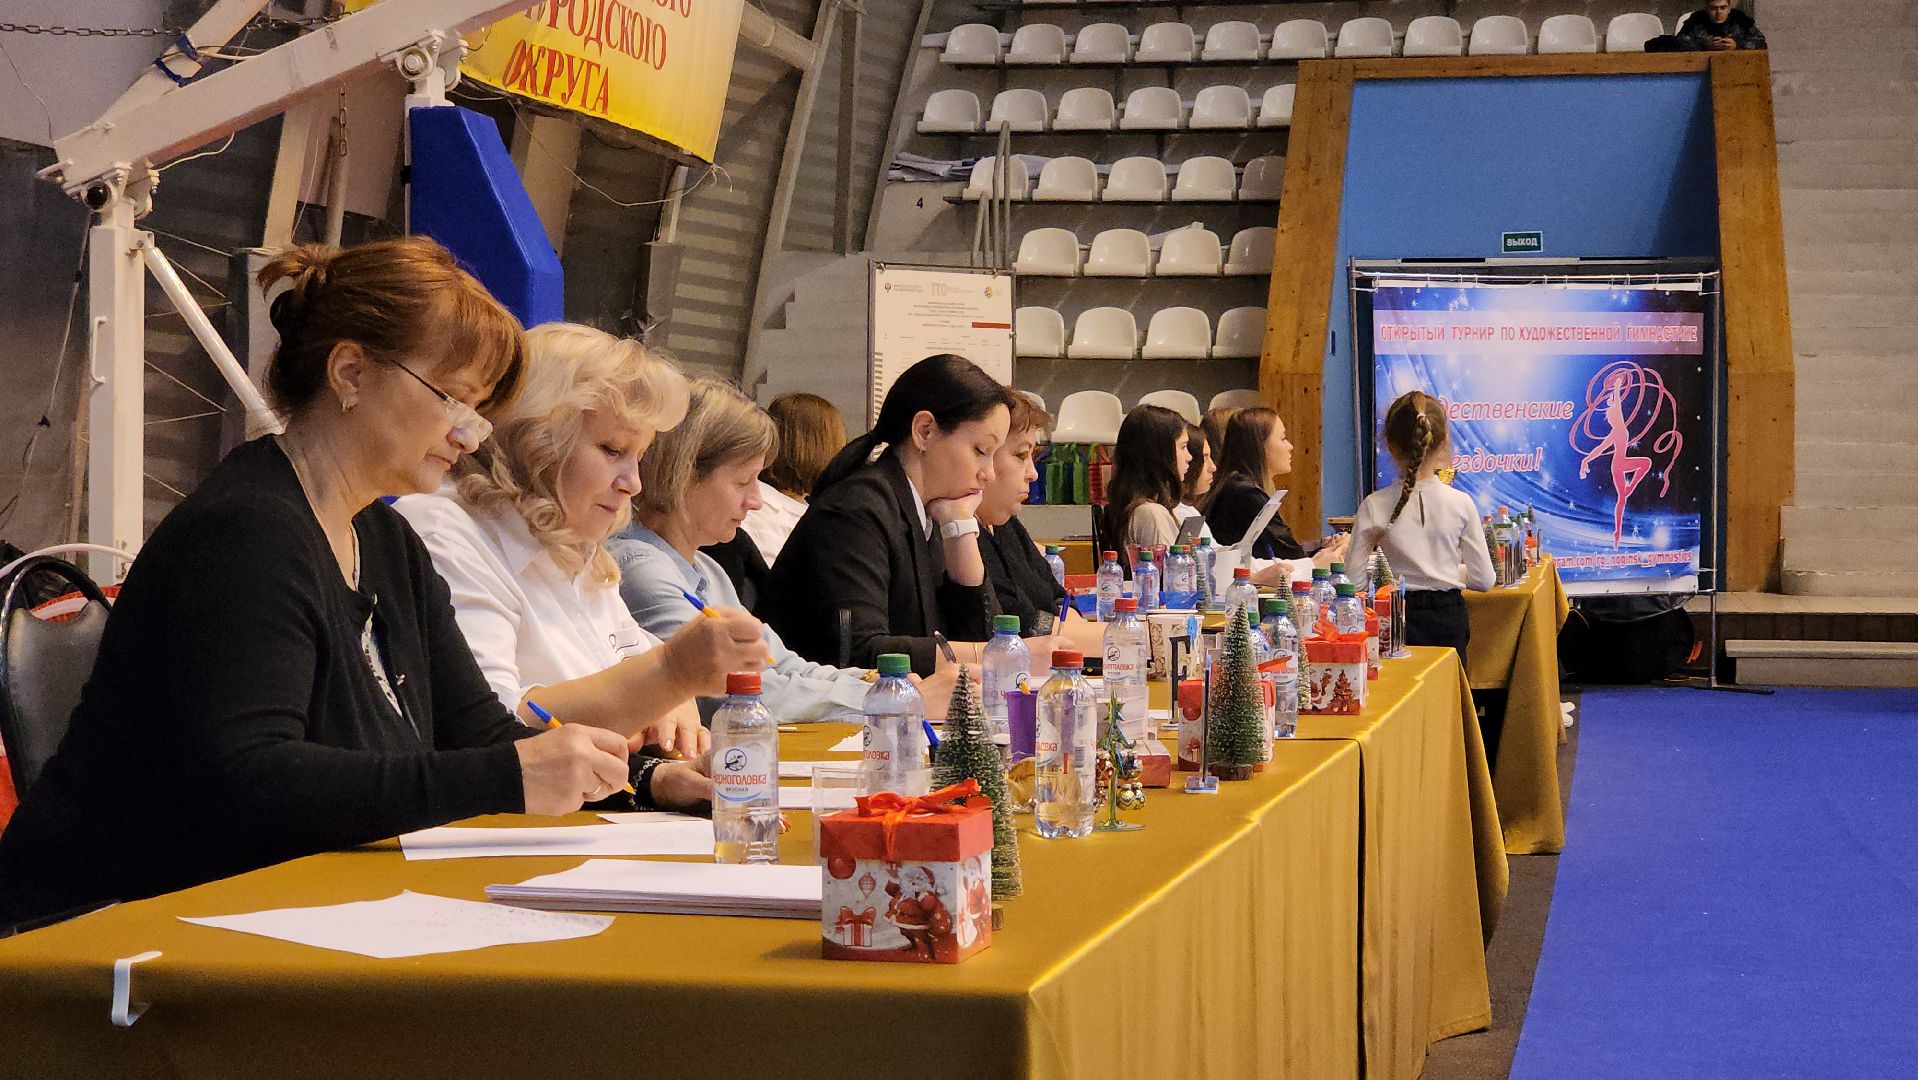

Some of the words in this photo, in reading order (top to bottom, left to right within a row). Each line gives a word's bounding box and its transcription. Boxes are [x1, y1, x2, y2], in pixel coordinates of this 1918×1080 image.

[502, 39, 609, 115] ОКРУГА
[916, 197, 924, 209] 4
[1506, 237, 1538, 247] ВЫХОД
[1380, 322, 1445, 341] ОТКРЫТЫЙ
[1451, 325, 1495, 341] ТУРНИР
[1500, 325, 1516, 341] ПО
[1518, 321, 1621, 343] ХУДОЖЕСТВЕННОЙ
[1625, 324, 1698, 343] ГИМНАСТИКЕ
[1450, 447, 1544, 474] ездочки!
